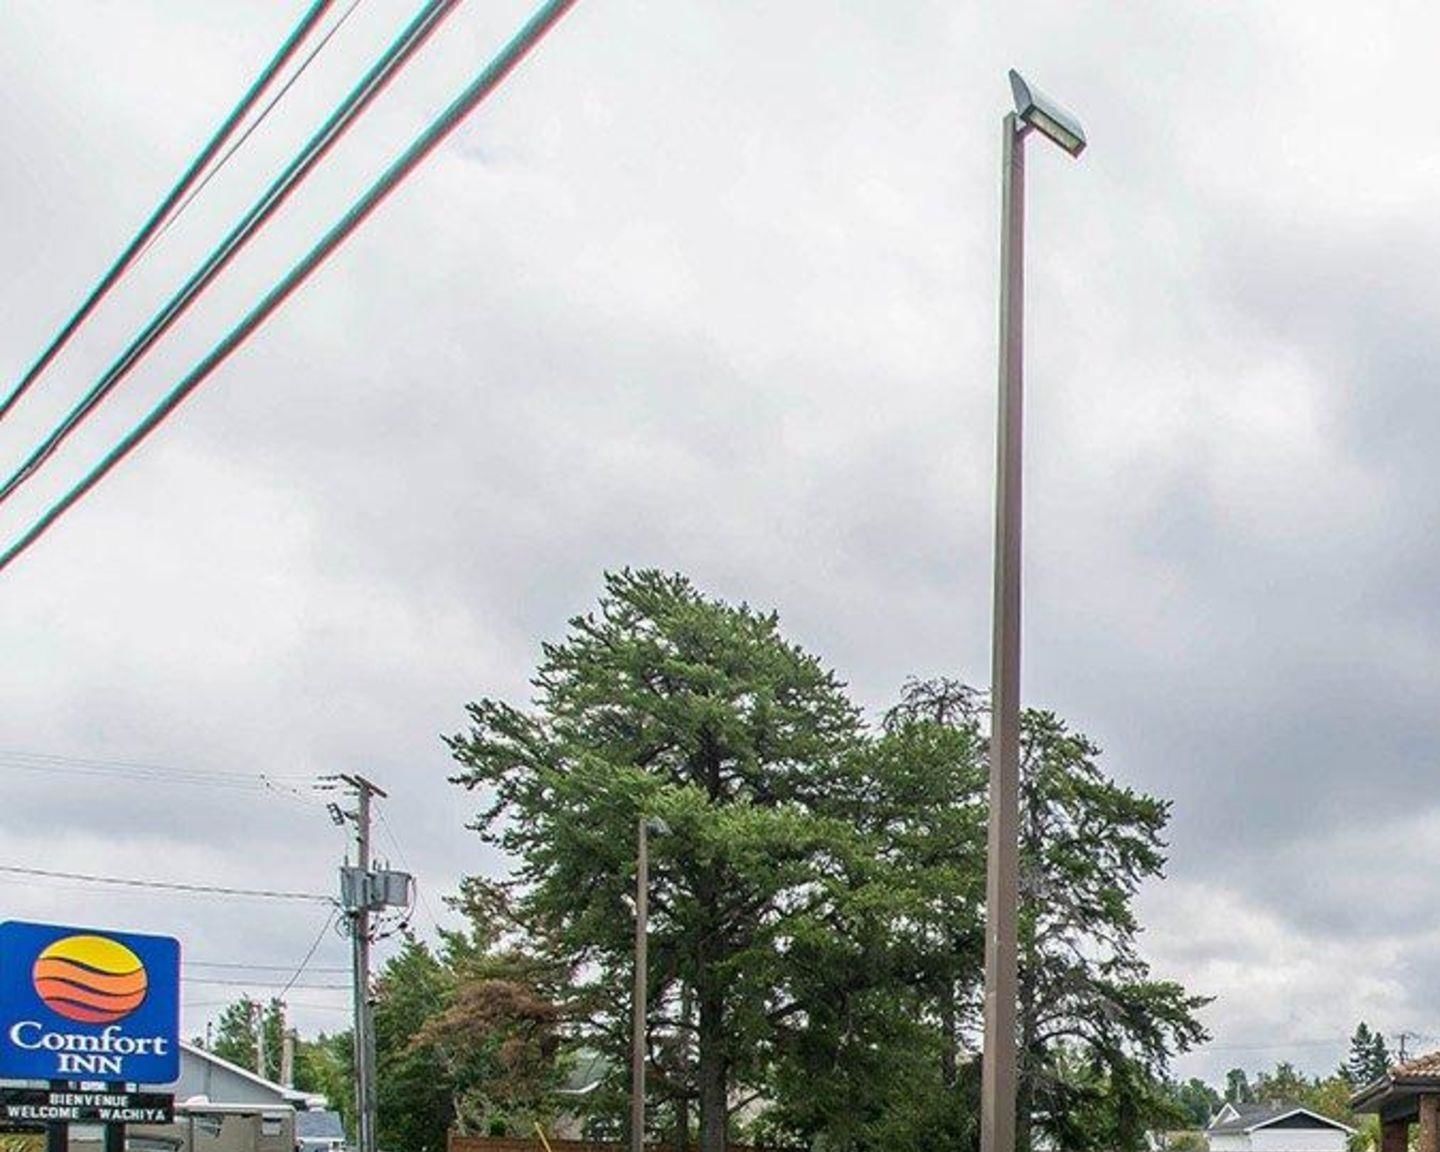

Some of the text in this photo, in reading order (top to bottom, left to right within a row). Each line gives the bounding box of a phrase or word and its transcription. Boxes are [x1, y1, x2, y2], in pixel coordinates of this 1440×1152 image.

[9, 1021, 168, 1055] Comfort
[58, 1053, 122, 1074] INN
[50, 1093, 129, 1107] BIENVENUE
[7, 1105, 166, 1121] WELCOME WACHIYA
